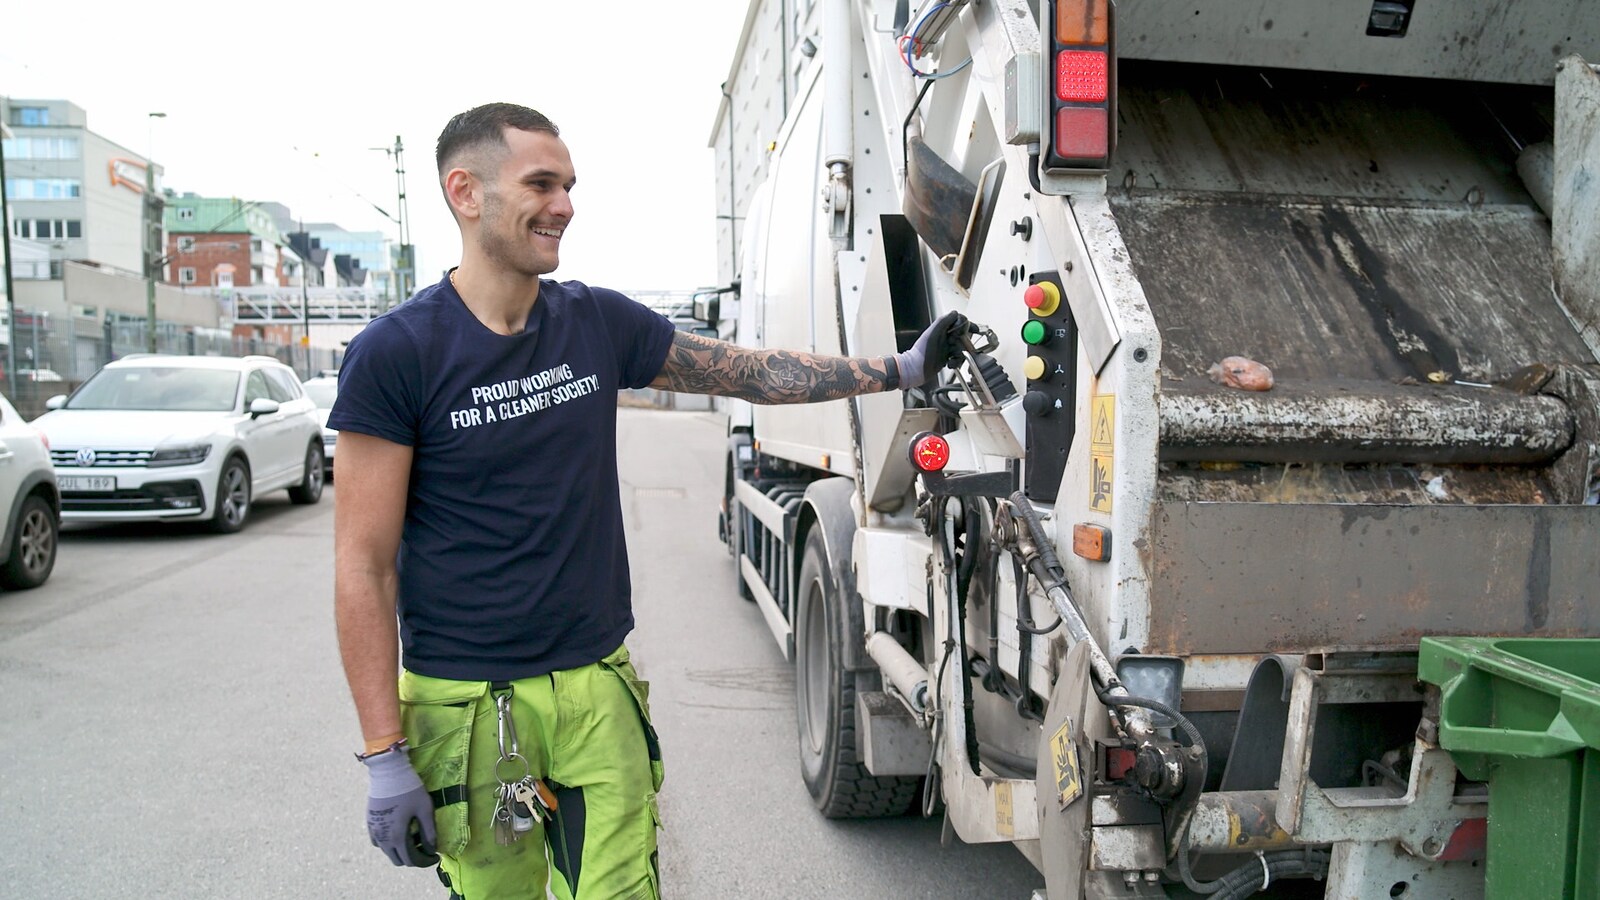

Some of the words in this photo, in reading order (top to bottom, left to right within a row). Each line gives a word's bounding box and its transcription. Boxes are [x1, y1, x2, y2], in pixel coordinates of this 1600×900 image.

[450, 409, 483, 430] FOR
[486, 405, 497, 424] A
[499, 390, 552, 421] CLEANER
[551, 373, 599, 405] SOCIETY!
[471, 380, 520, 405] PROUD
[520, 363, 574, 395] WORKING
